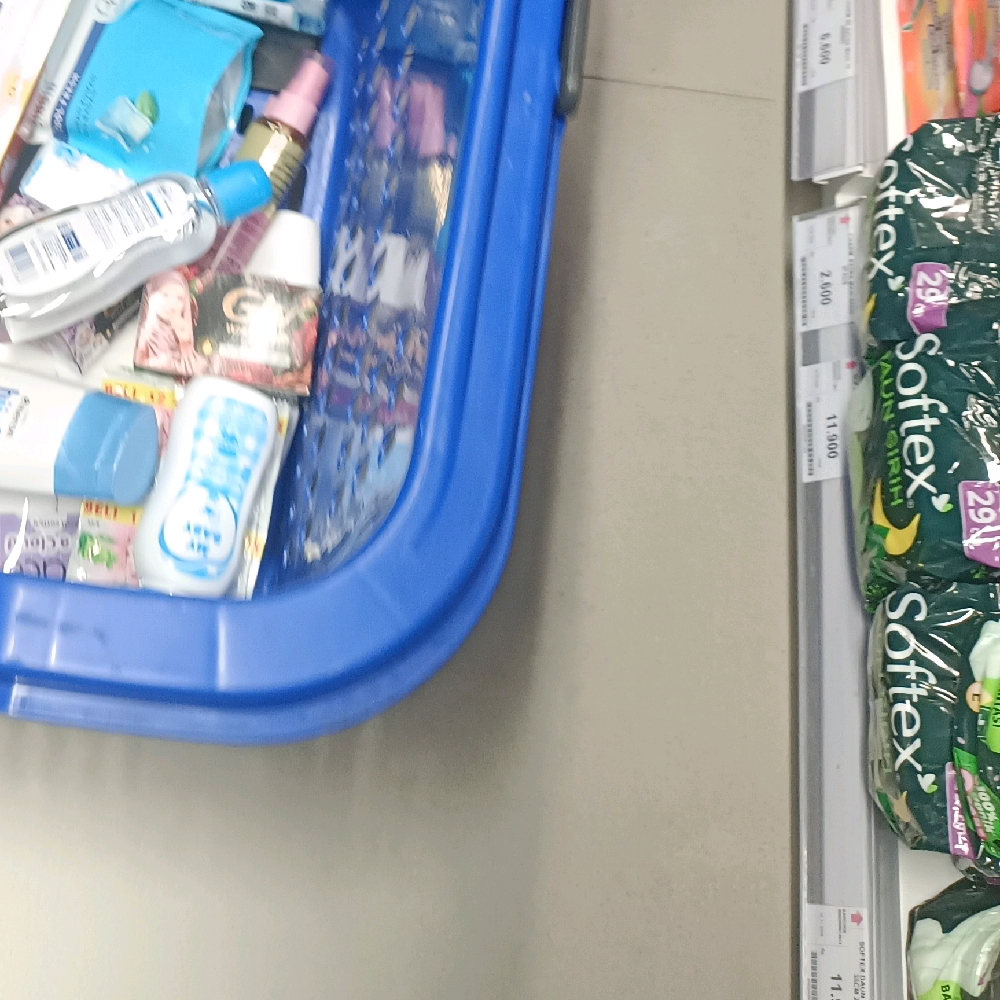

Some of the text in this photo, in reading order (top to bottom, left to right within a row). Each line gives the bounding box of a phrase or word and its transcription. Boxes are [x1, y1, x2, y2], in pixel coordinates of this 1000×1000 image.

[825, 414, 839, 459] 11.900
[894, 333, 946, 500] Softex
[882, 591, 936, 772] Softex
